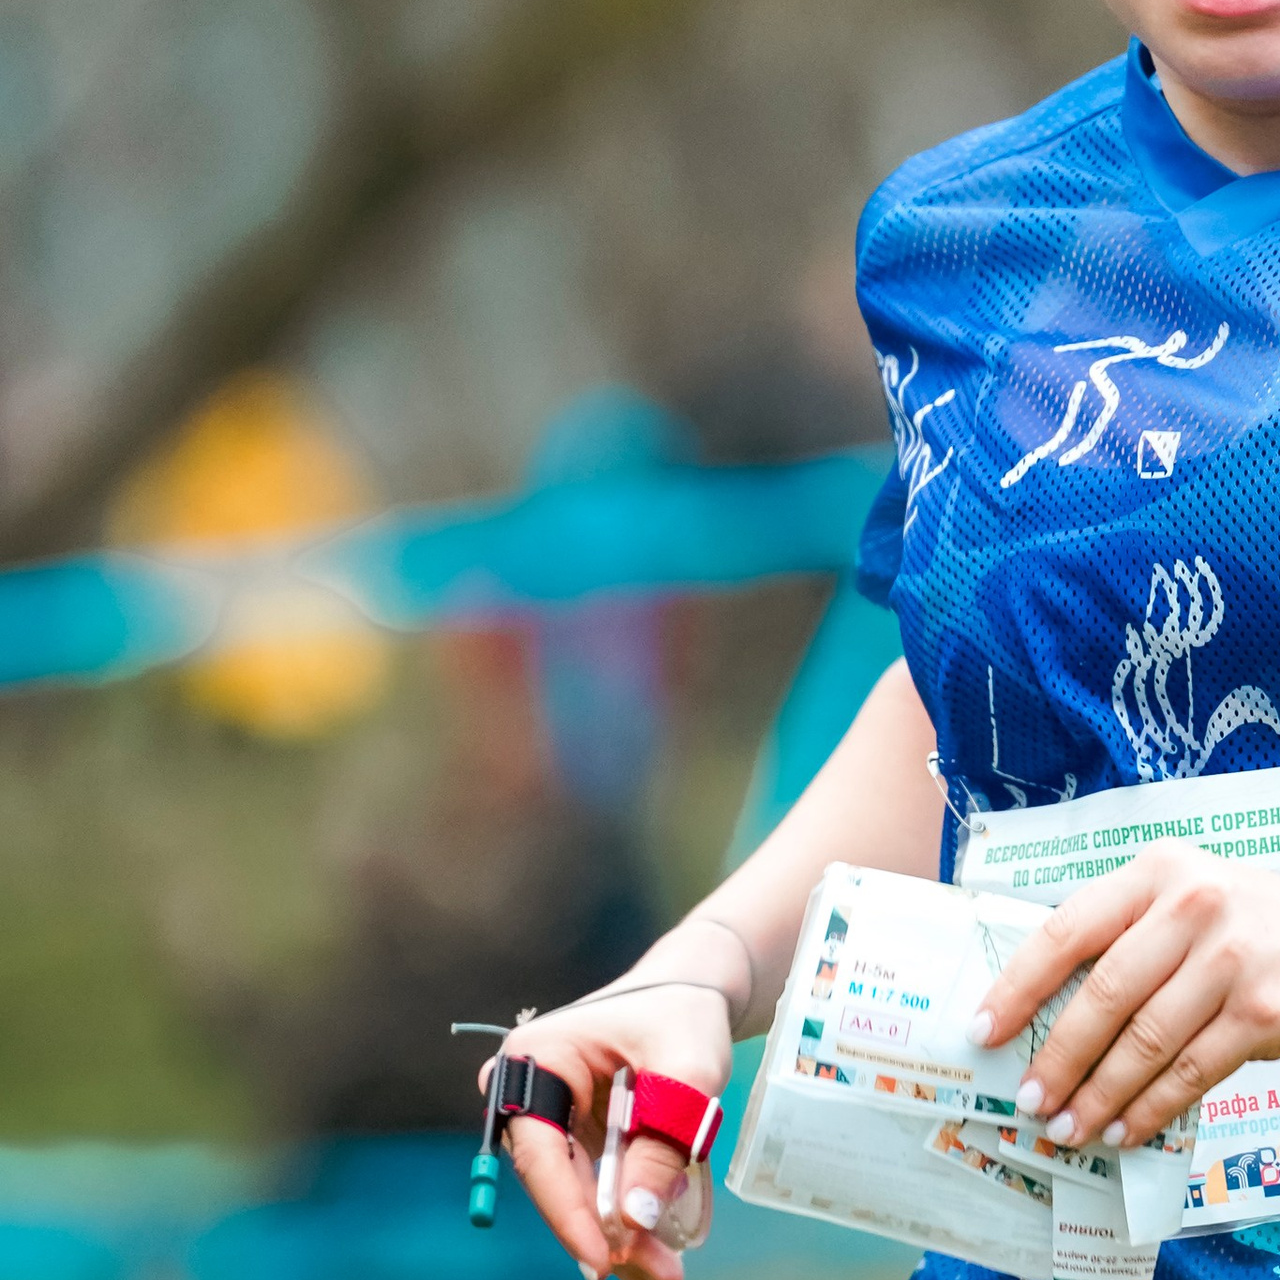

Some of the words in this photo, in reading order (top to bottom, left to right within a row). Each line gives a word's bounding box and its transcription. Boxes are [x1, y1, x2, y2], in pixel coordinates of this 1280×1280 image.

[984, 832, 1088, 864] ВСЕРОССИЙСКИЕ
[1093, 817, 1204, 848] СПОРТИВНЫЕ
[1013, 869, 1029, 887] ПО
